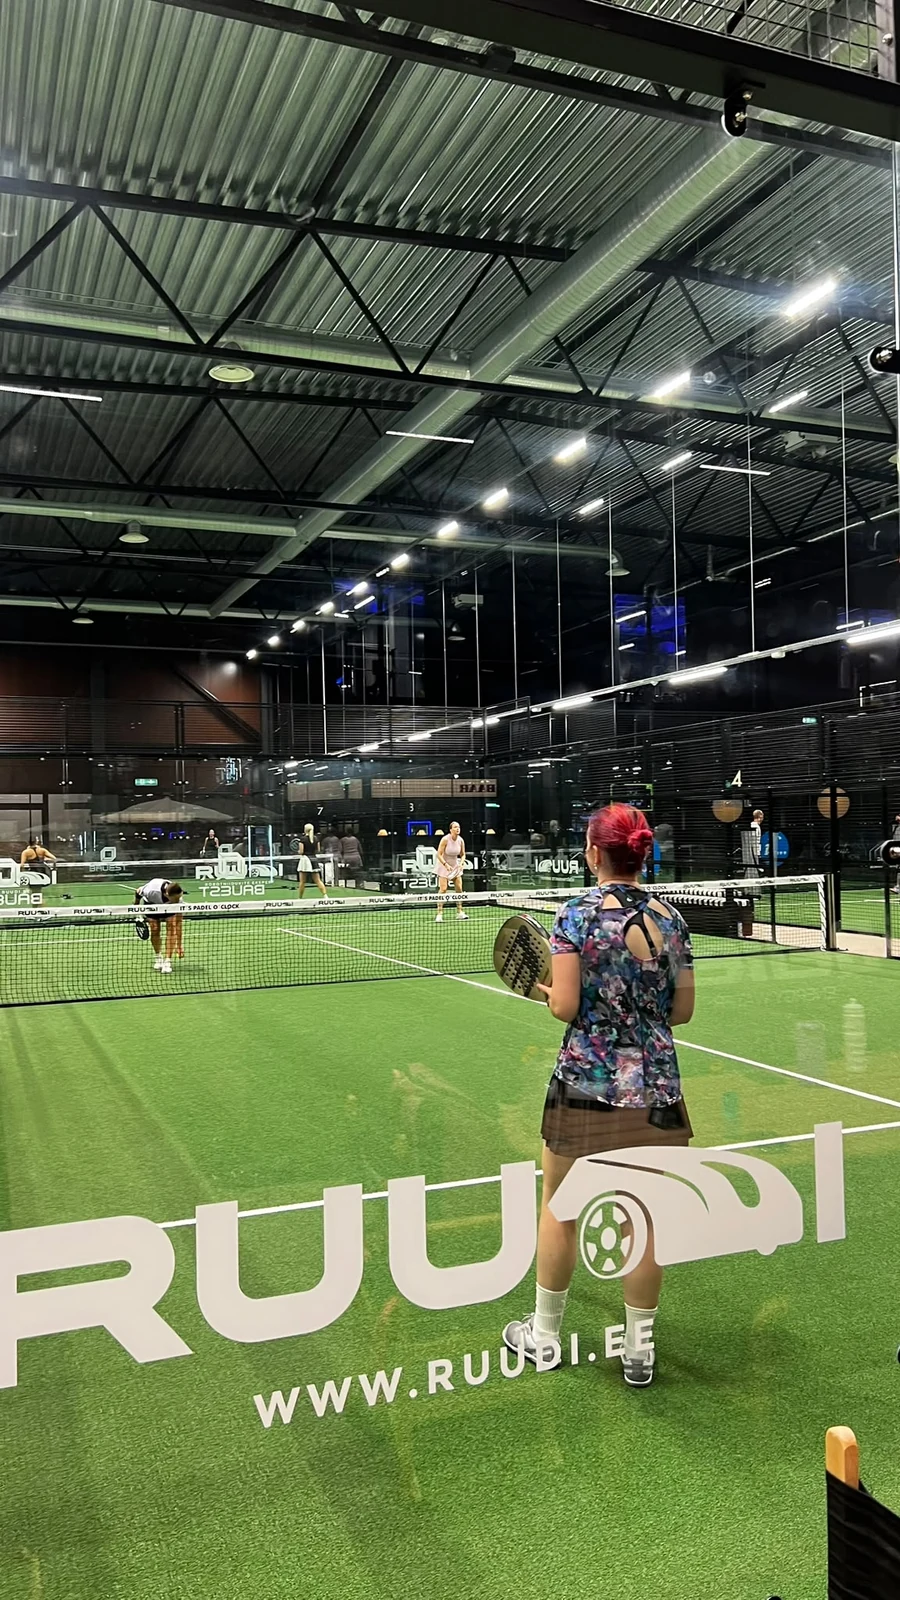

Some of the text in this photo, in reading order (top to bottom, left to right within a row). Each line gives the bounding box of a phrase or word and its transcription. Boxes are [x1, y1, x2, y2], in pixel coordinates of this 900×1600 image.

[731, 769, 743, 787] 4
[317, 807, 324, 816] 7
[253, 1318, 656, 1428] WWW.RUUDI.EE
